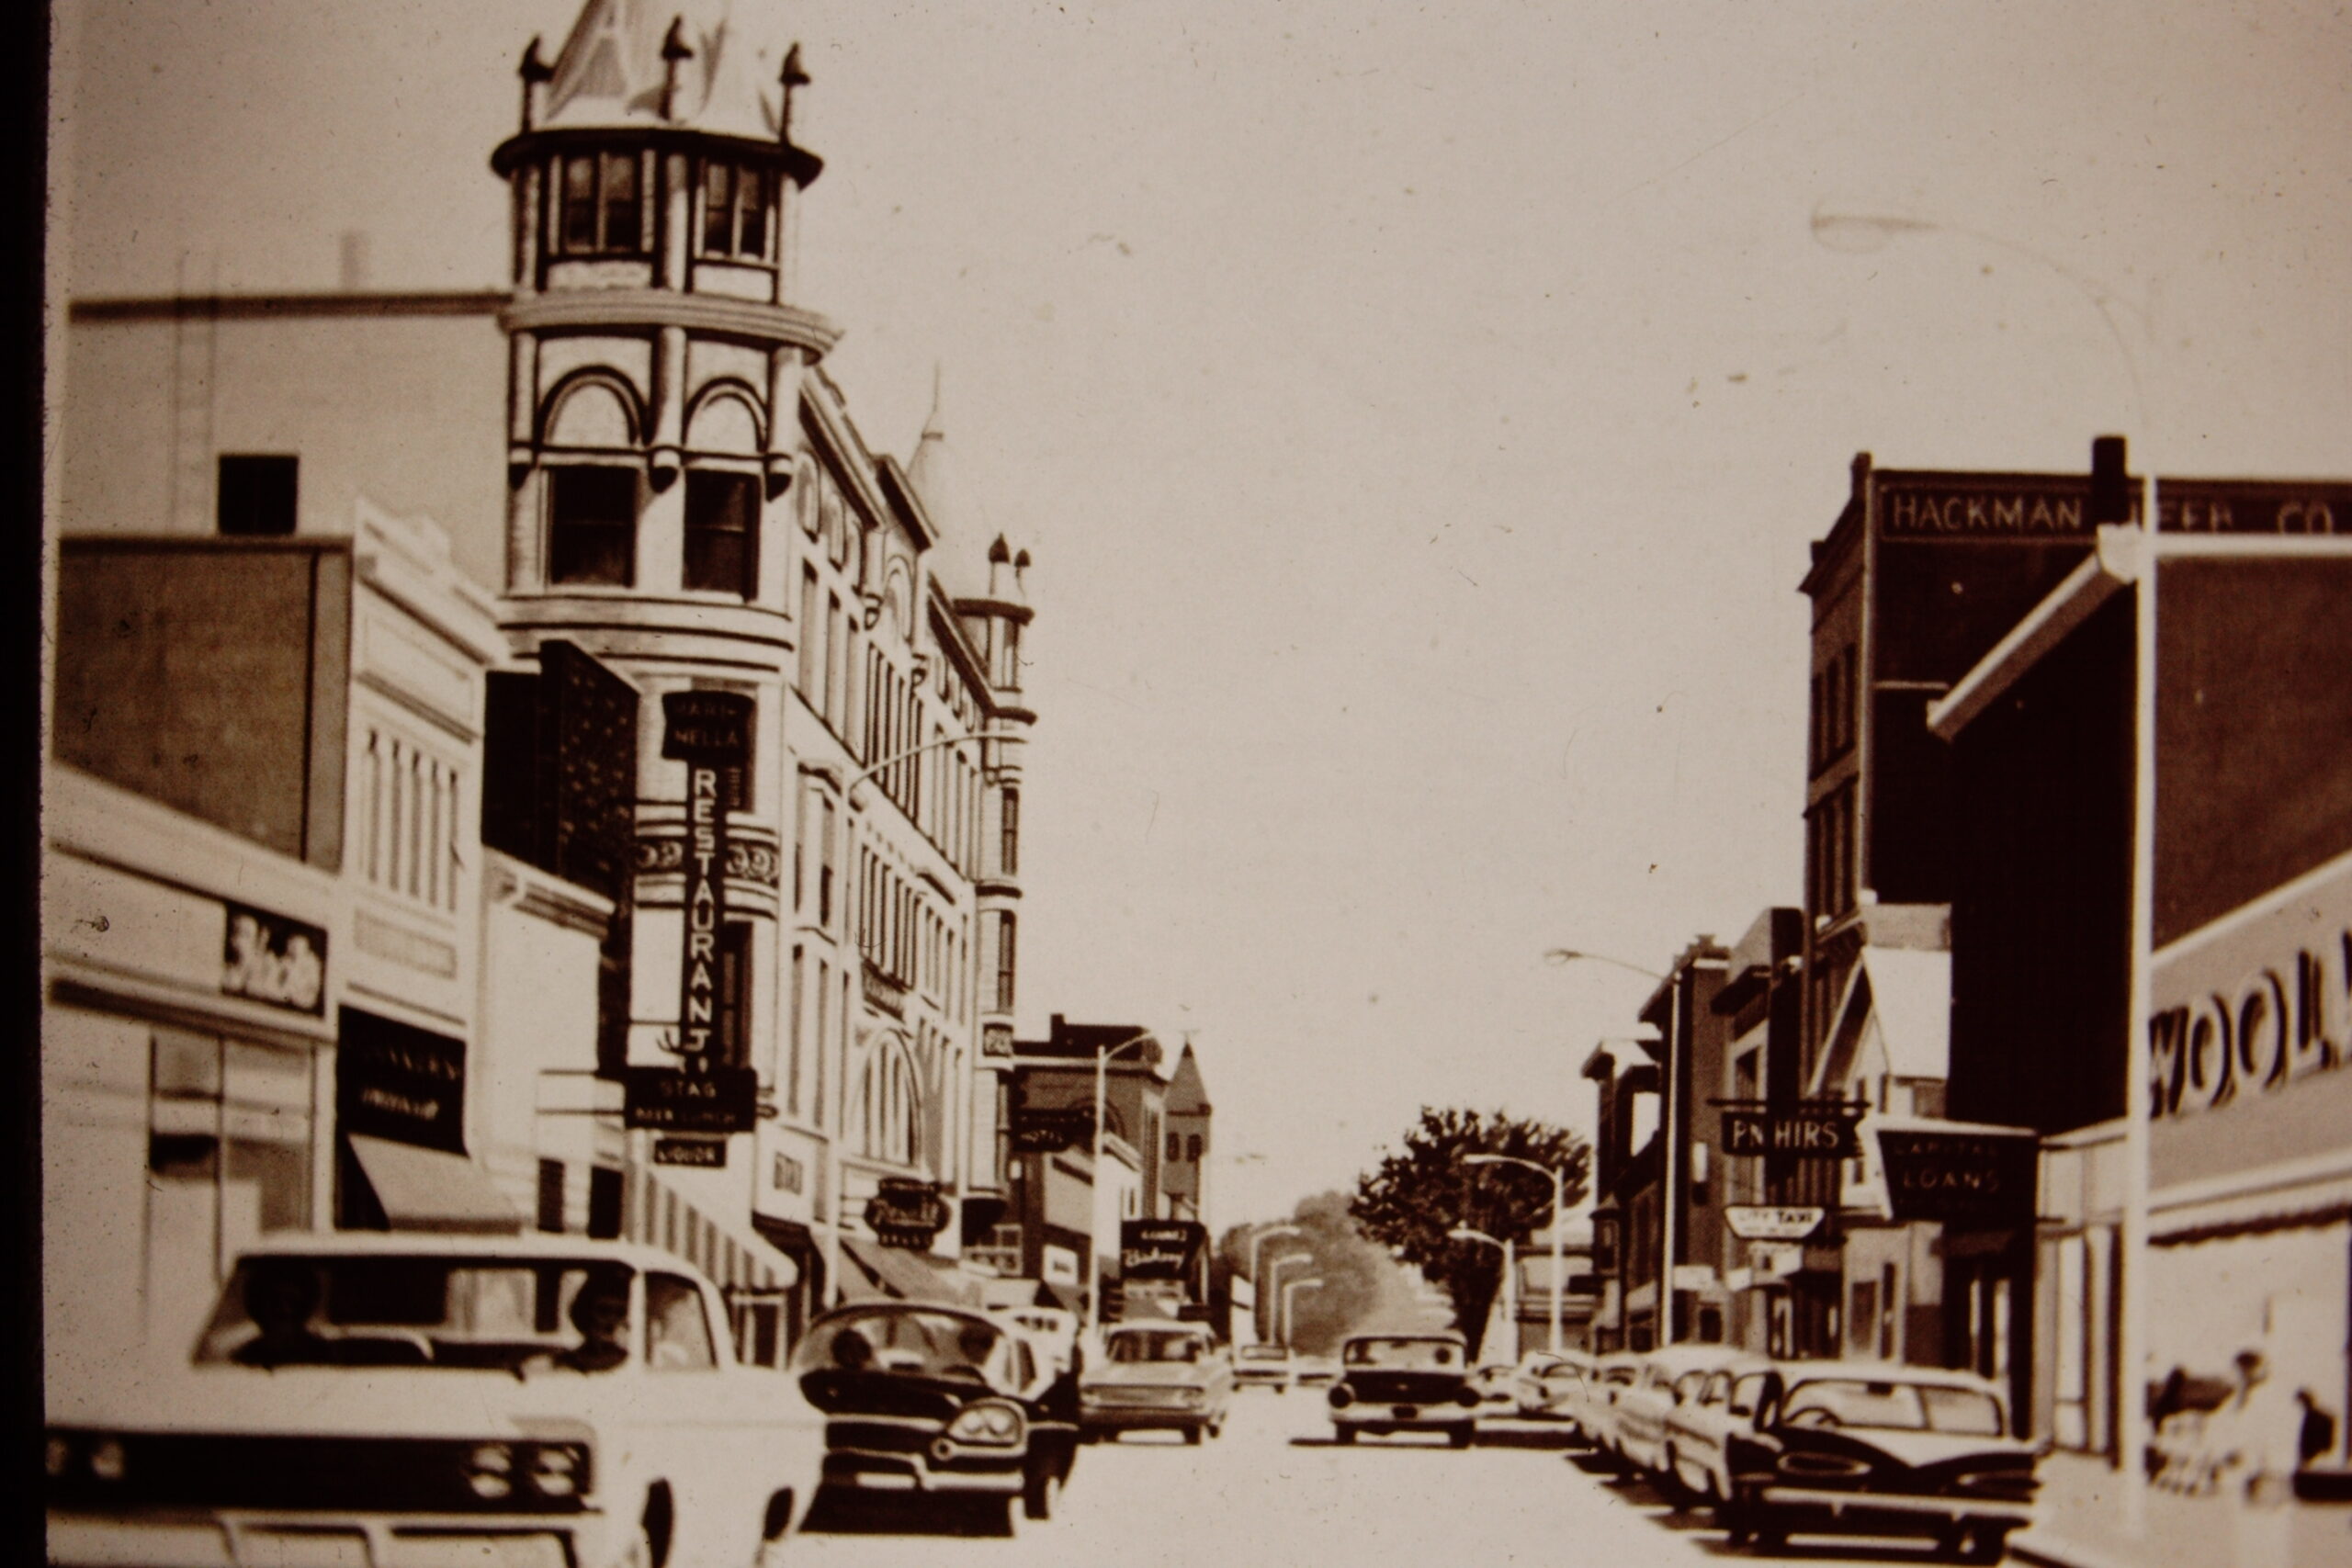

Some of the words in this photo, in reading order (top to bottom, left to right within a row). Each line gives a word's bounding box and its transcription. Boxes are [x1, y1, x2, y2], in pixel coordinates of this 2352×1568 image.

[1893, 494, 2082, 531] HACKMAN
[687, 768, 718, 1052] RESTAURANT
[659, 1078, 718, 1098] STAG
[1903, 1167, 2001, 1194] LOANS
[1777, 1211, 1813, 1224] TAXI
